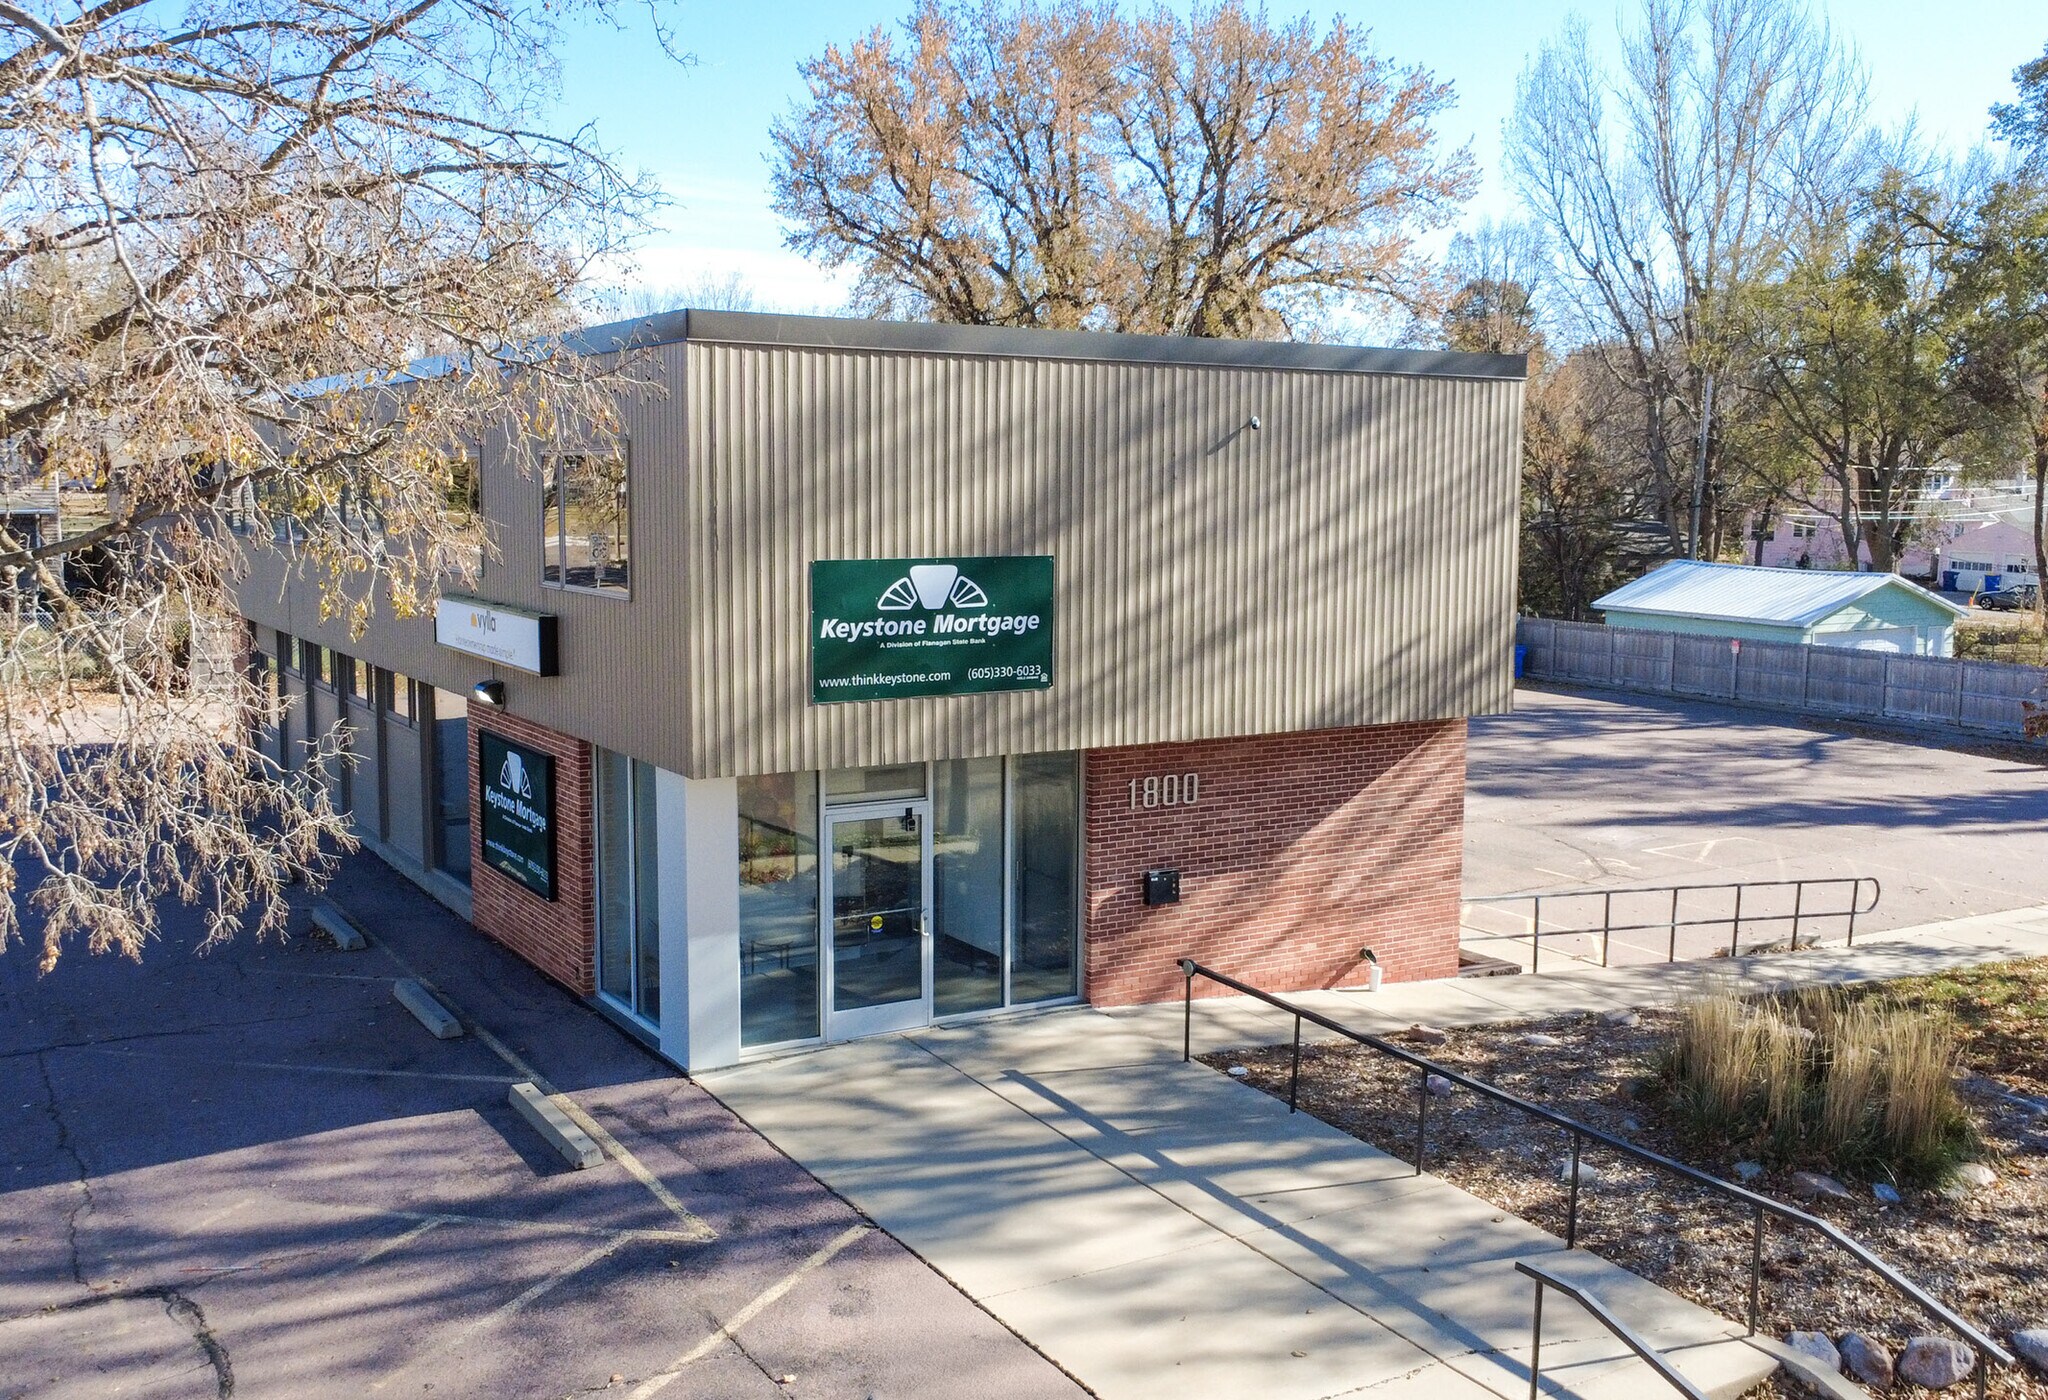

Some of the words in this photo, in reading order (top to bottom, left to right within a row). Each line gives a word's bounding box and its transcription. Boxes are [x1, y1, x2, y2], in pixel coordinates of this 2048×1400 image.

[477, 610, 497, 636] vylla
[820, 618, 927, 643] Keystone
[933, 612, 1040, 637] Mortgage
[886, 641, 913, 649] Division
[922, 639, 952, 647] Flanagan
[952, 637, 969, 646] State
[969, 636, 986, 644] Bank
[819, 670, 951, 688] www.thinkkeystone.com
[967, 663, 1042, 681] (605)330-6033
[1128, 772, 1199, 810] 1800
[485, 784, 516, 814] Keystone
[515, 798, 547, 833] Mortgage
